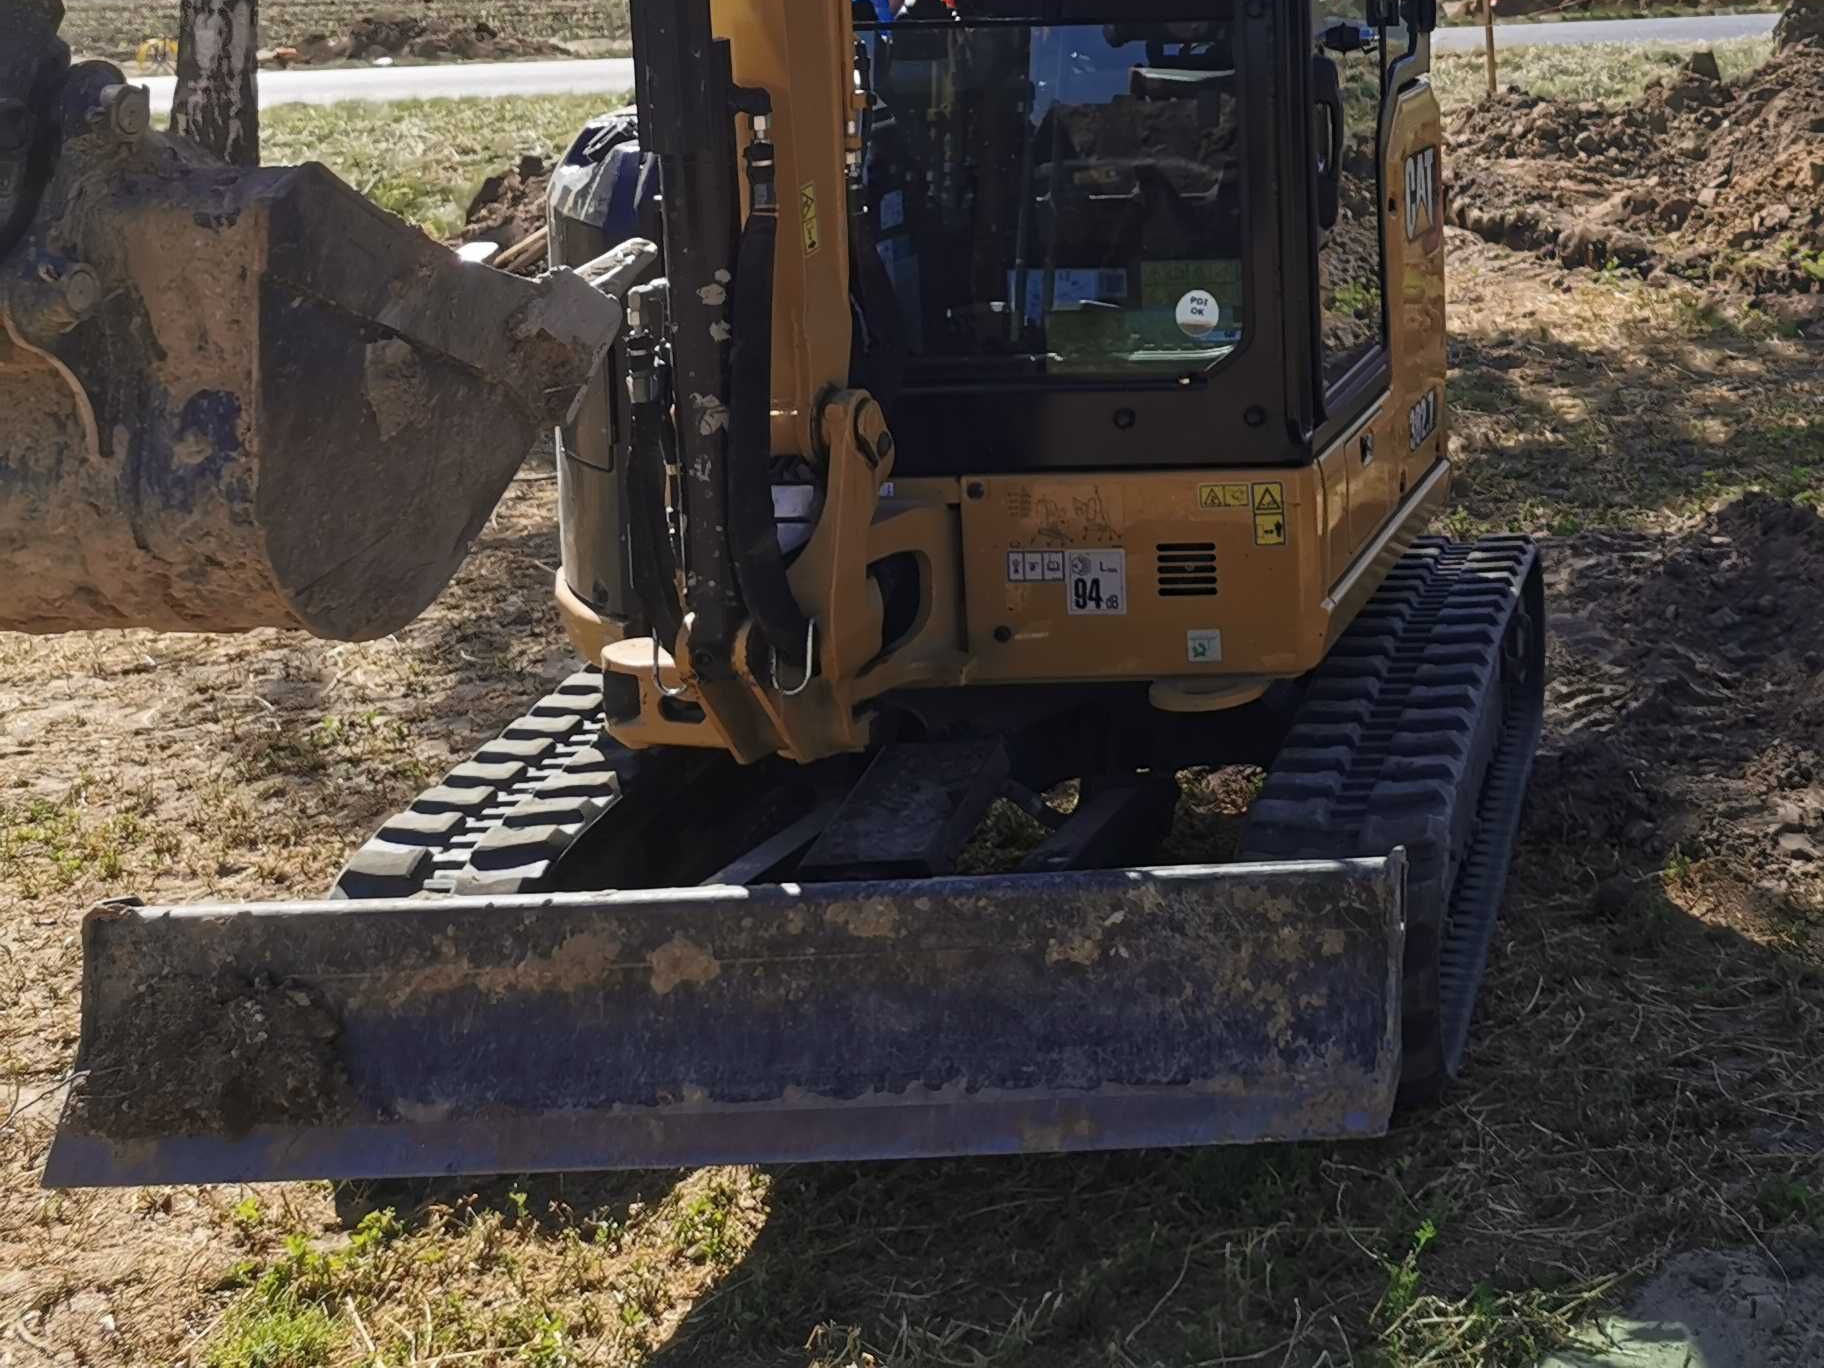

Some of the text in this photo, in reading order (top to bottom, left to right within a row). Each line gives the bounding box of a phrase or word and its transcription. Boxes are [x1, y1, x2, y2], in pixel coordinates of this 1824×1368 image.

[1405, 147, 1434, 240] CAT
[1190, 307, 1205, 316] OK
[1074, 577, 1103, 609] 94
